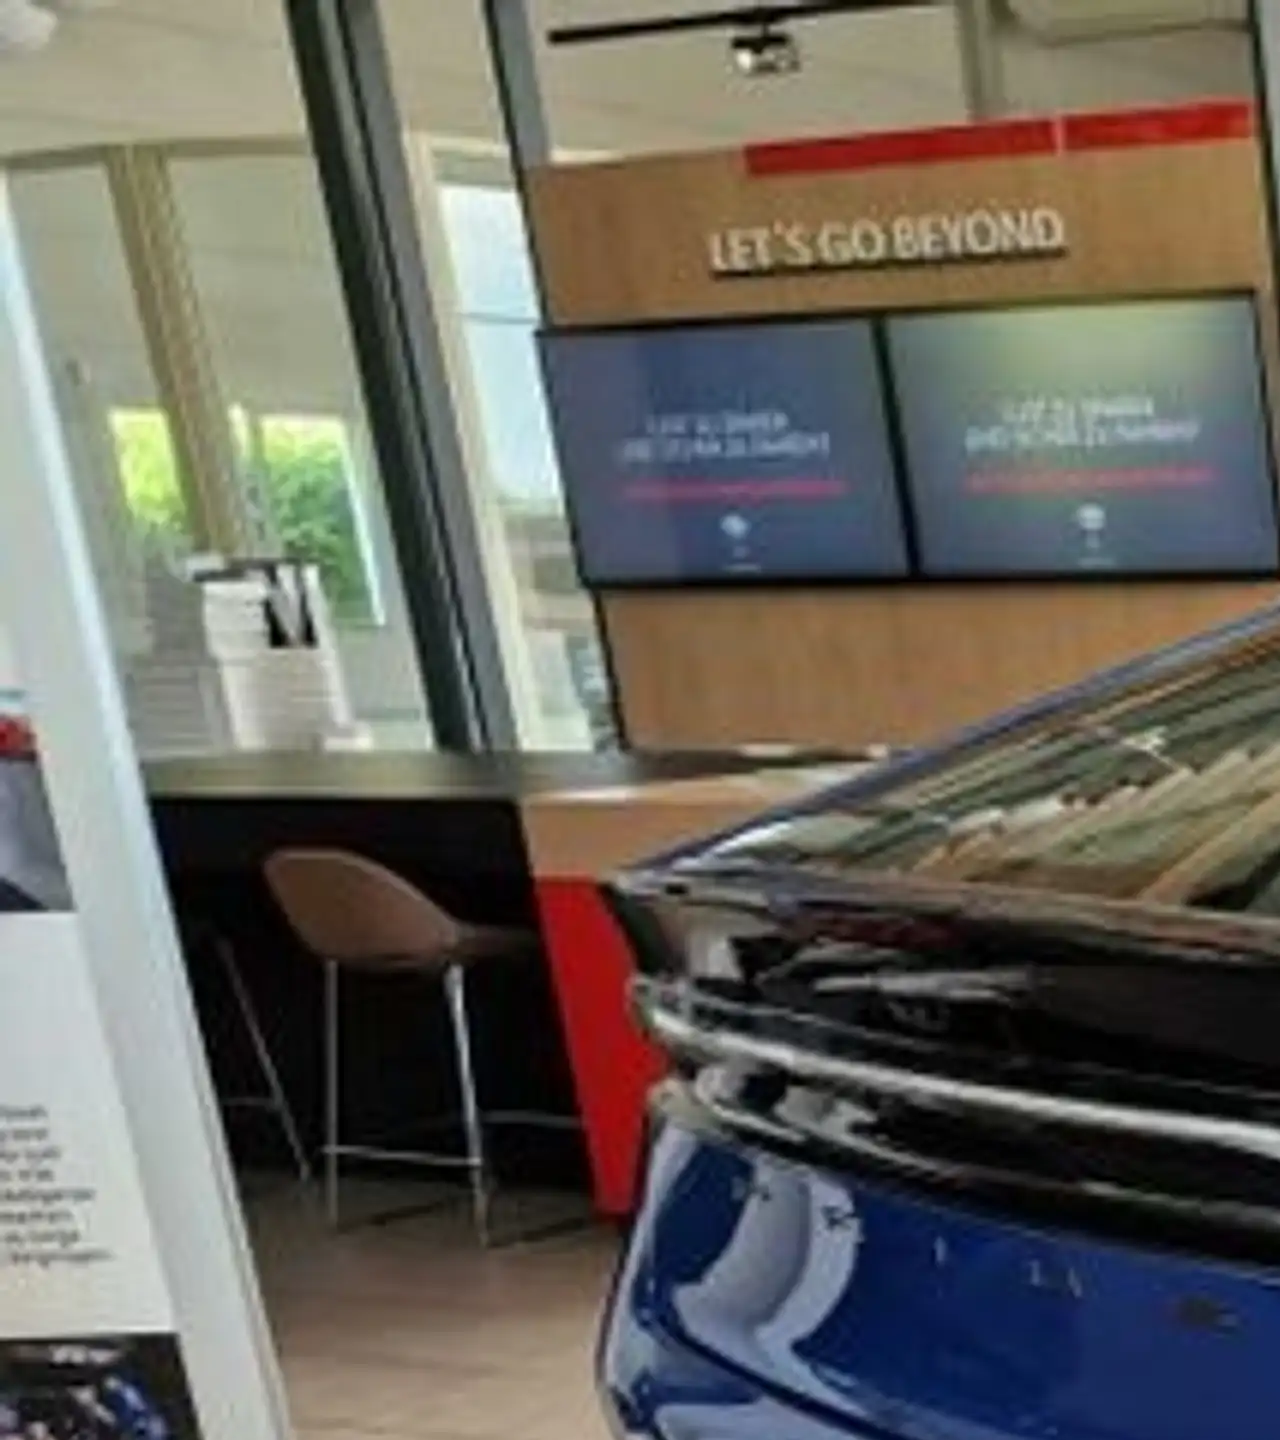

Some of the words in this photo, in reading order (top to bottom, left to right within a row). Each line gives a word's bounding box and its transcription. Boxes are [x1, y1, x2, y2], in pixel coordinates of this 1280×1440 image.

[708, 218, 815, 273] LET'S
[817, 218, 888, 268] GO
[891, 206, 1066, 261] BEYOND
